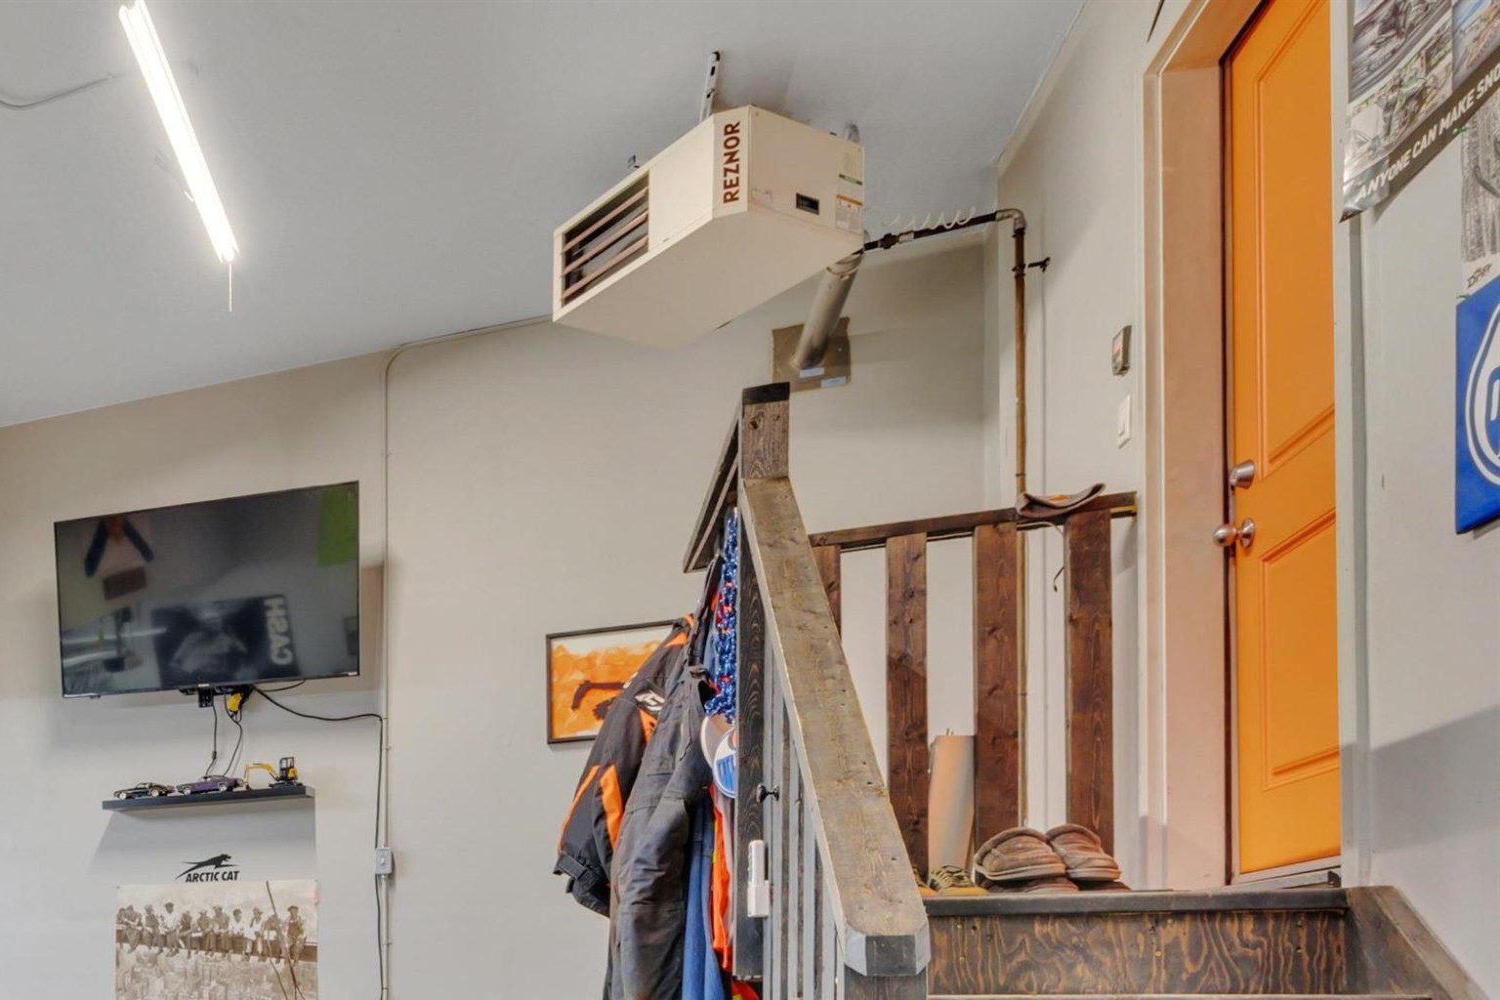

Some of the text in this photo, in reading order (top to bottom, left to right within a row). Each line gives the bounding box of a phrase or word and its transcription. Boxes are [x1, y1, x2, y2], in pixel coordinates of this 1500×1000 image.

[723, 121, 741, 205] REZNOR
[1354, 149, 1412, 203] ANYONE
[1412, 124, 1438, 159] CAN
[1438, 88, 1475, 135] MAKE
[185, 870, 240, 883] ARCTIC CAT
